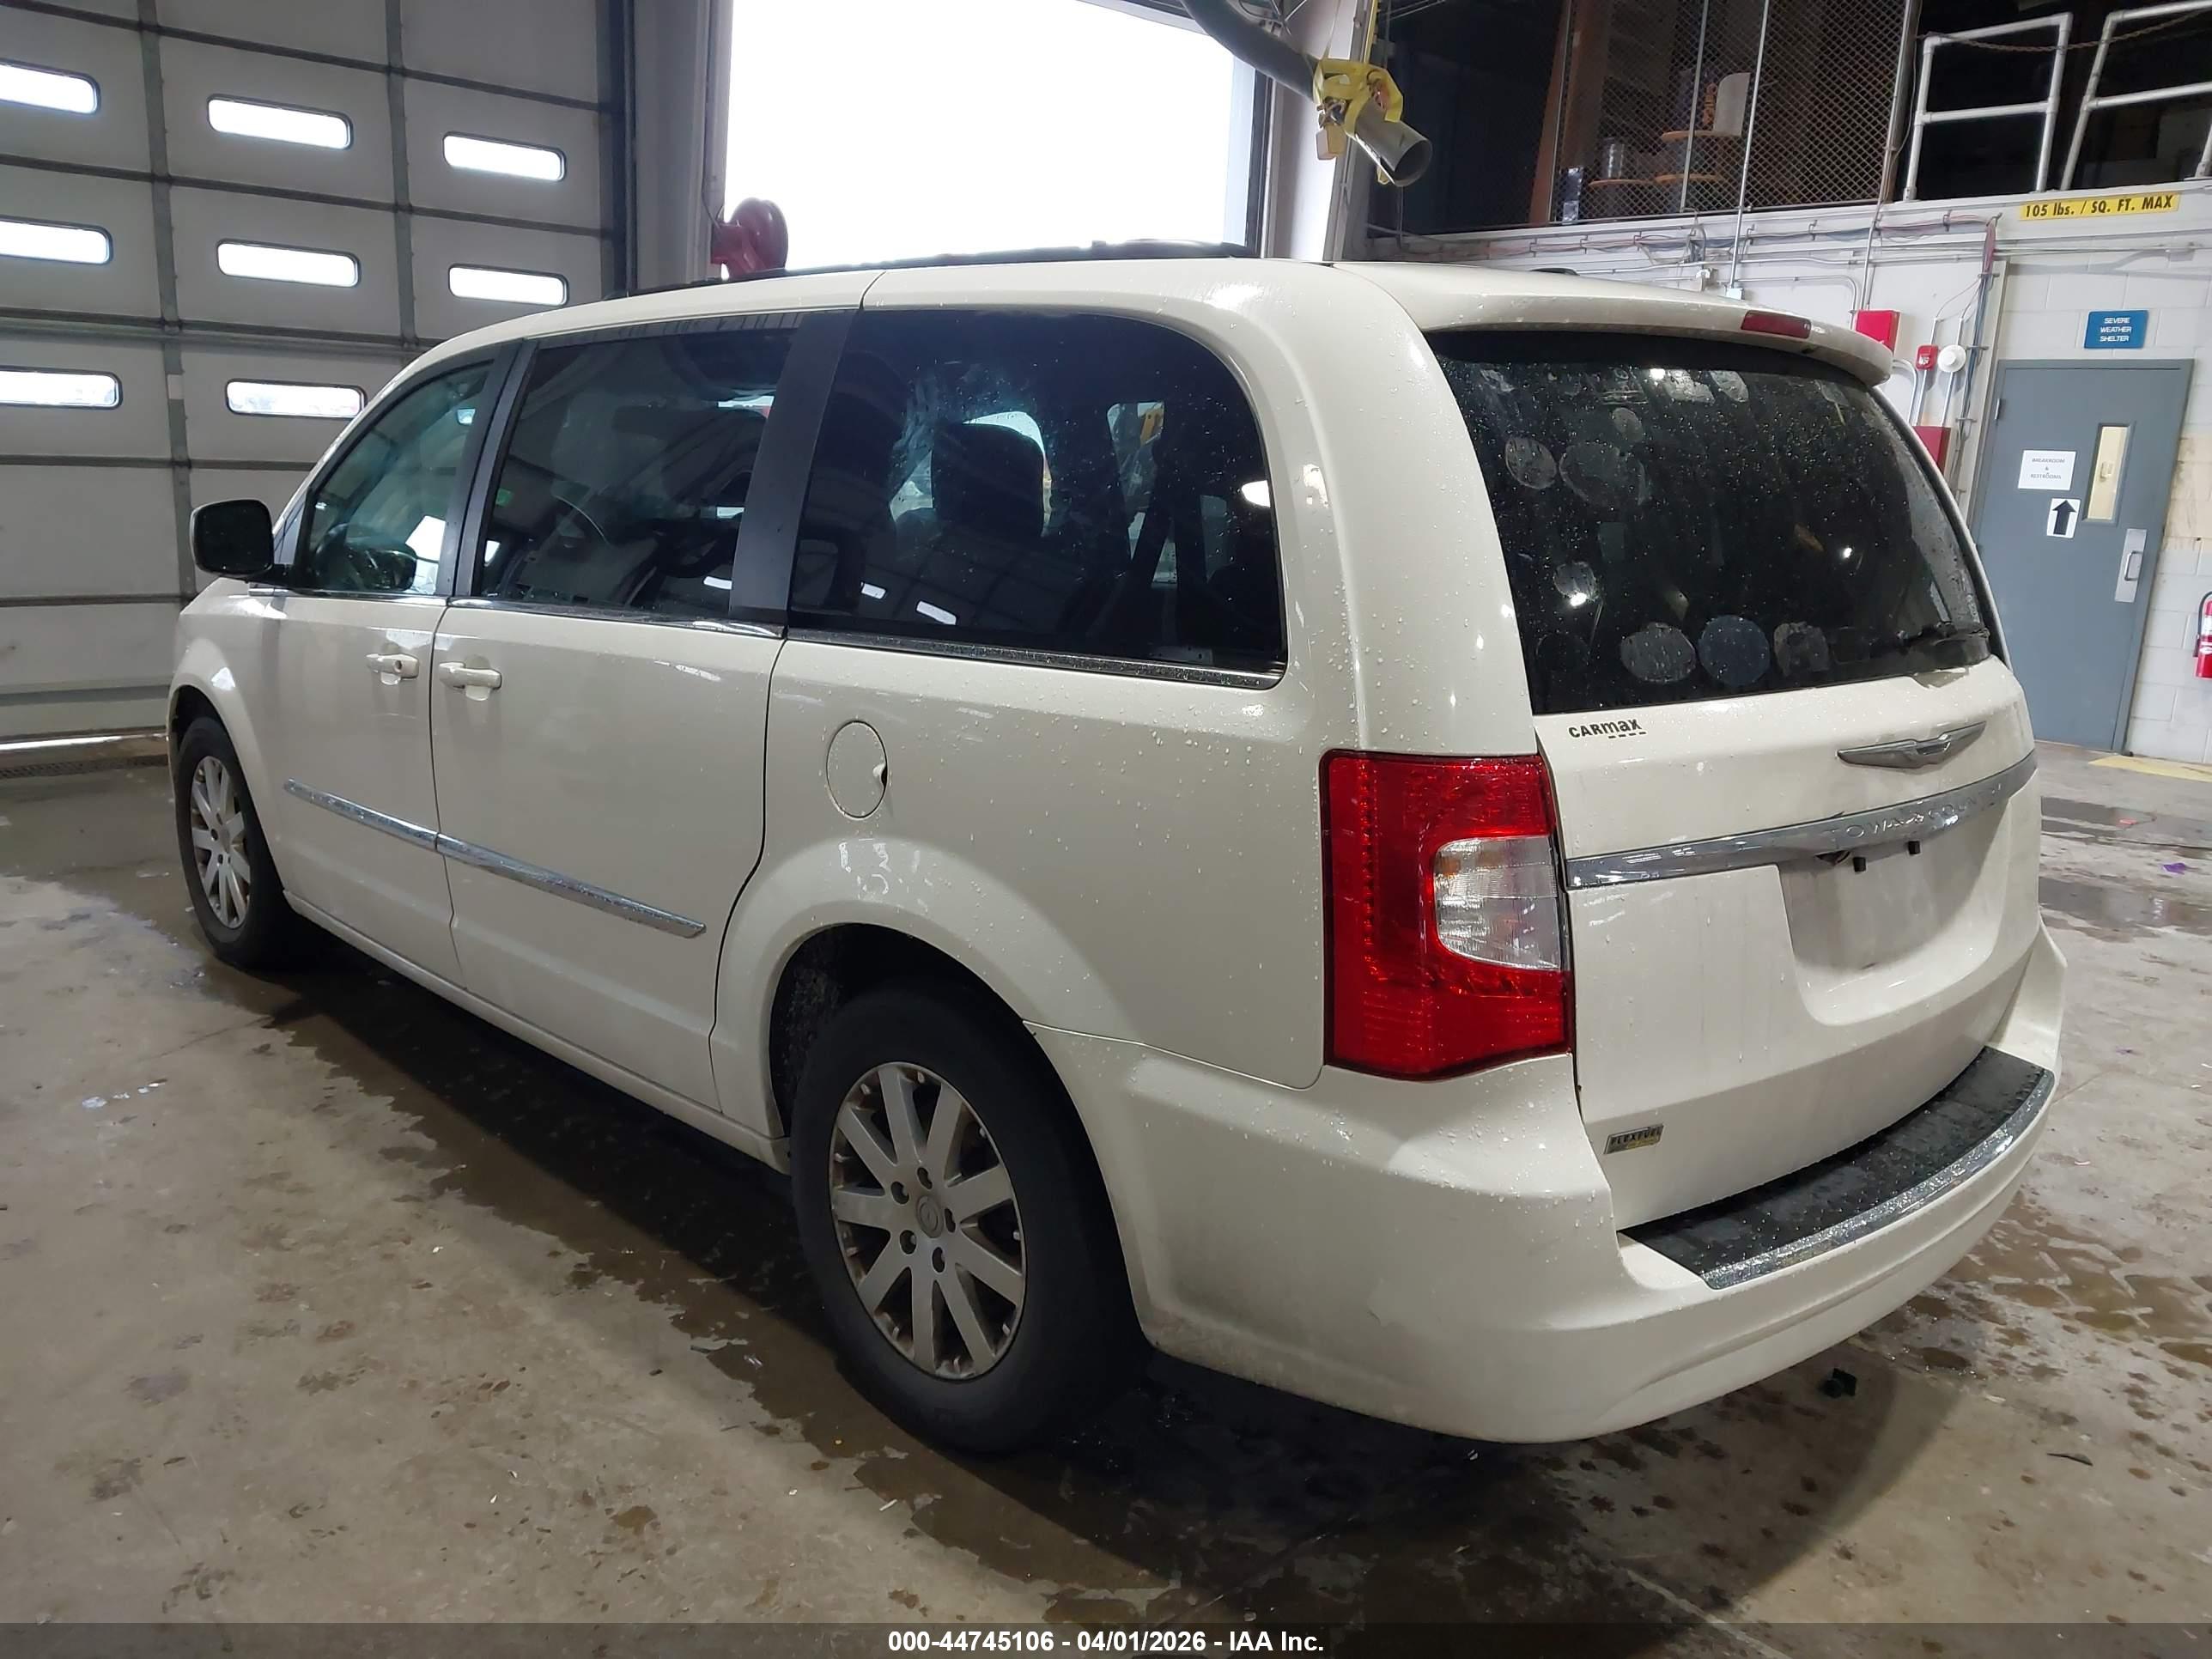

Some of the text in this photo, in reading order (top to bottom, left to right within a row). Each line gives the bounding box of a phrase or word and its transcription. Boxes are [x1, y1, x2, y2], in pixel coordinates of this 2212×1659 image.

[2026, 194, 2173, 217] 105 lbs. / SQ. FT. MAX
